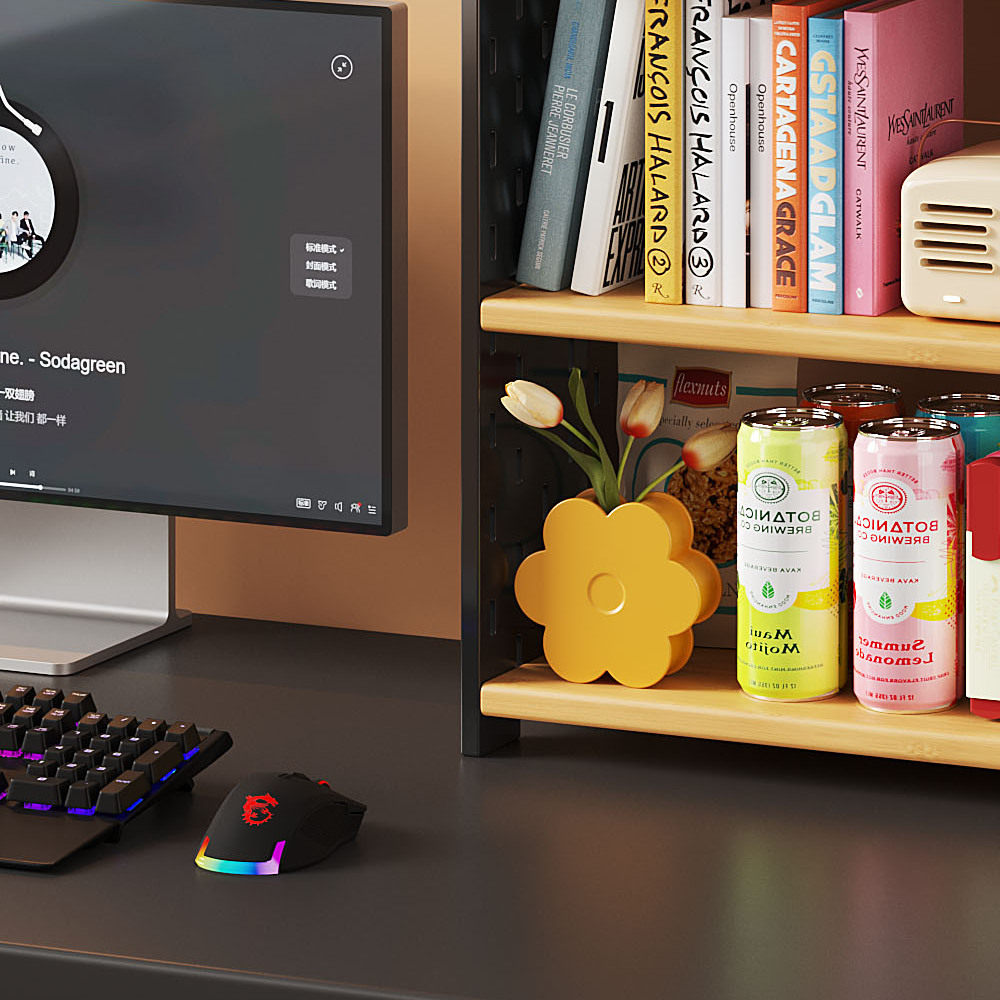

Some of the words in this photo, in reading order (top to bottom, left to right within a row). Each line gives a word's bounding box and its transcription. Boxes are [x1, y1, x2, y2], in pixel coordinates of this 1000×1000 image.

[549, 84, 565, 119] PIERRE
[565, 87, 578, 101] LE
[727, 83, 738, 152] Openhouse
[757, 83, 767, 153] Openhouse
[775, 39, 797, 201] CARTAGENA
[809, 49, 837, 193] GSTAAD
[540, 120, 560, 176] JEANNERET
[556, 103, 577, 160] CORBUSIER
[775, 201, 797, 287] GRACE
[809, 190, 837, 292] GLAM
[0, 350, 24, 366] ne.
[39, 350, 126, 376] Sodagreen
[673, 372, 727, 397] flexnuts
